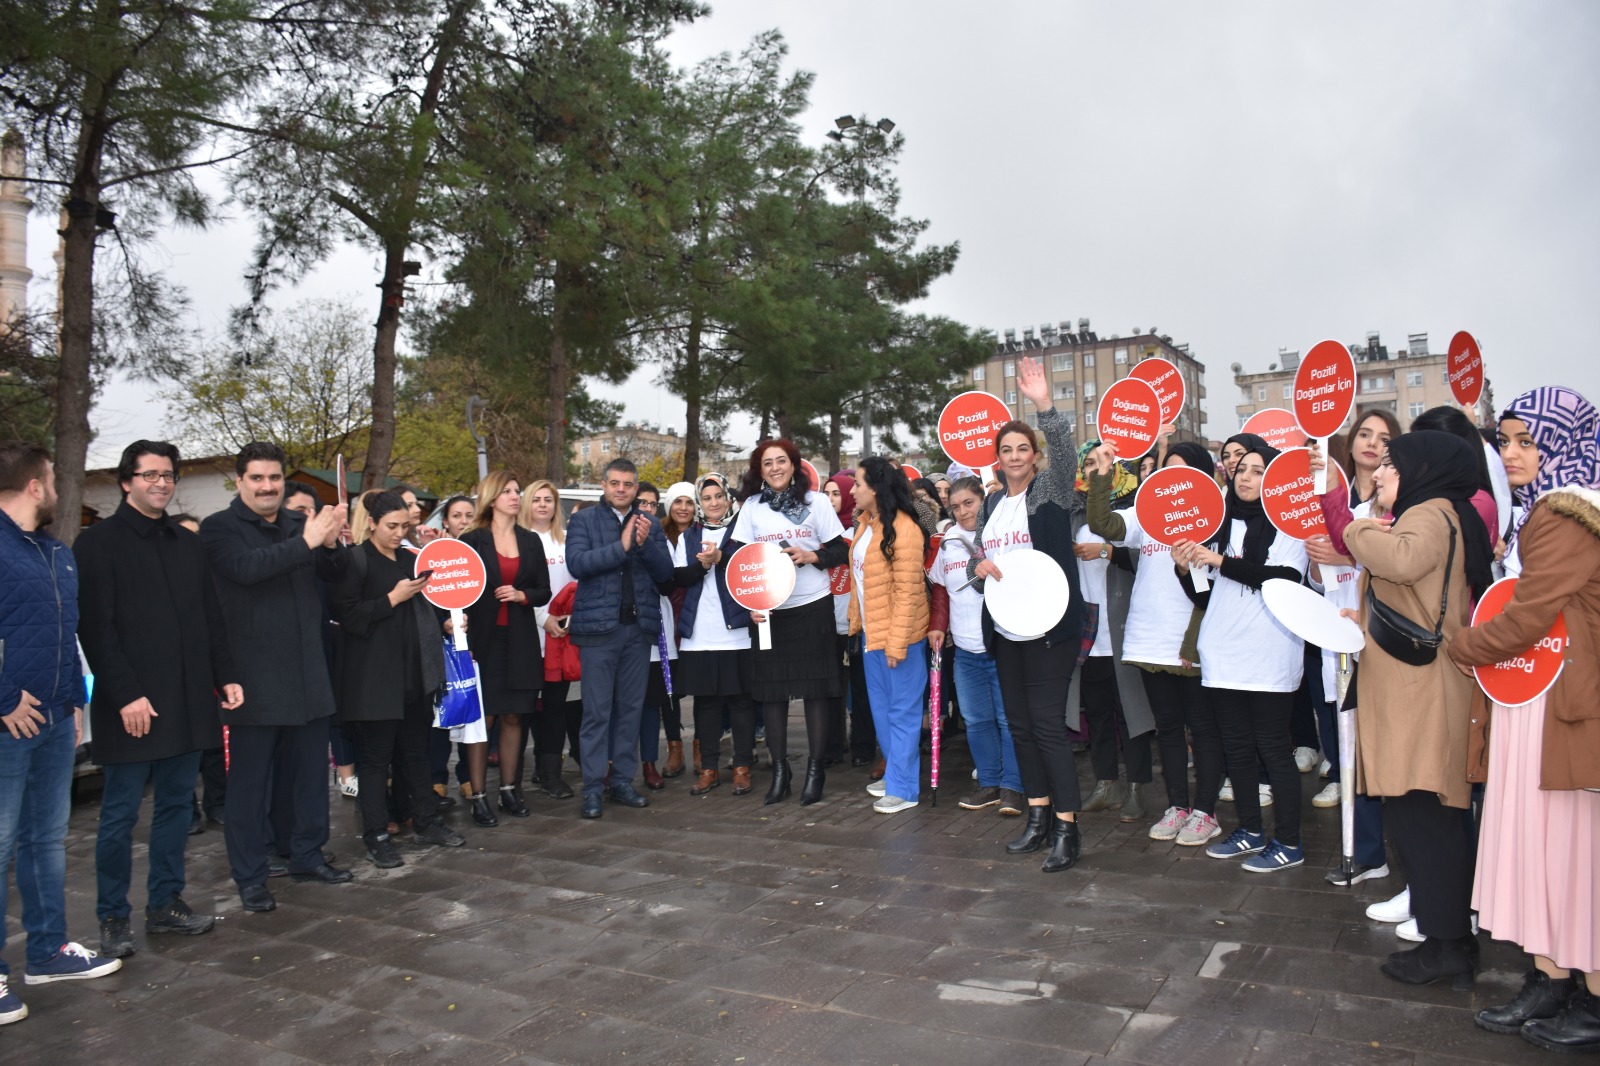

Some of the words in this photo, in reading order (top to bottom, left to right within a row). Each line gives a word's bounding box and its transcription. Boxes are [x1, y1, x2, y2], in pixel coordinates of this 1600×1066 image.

[1310, 362, 1338, 381] Pozitif
[1296, 382, 1336, 401] Doğumlar
[1337, 376, 1352, 392] İçin
[1112, 397, 1150, 413] Doğumda
[1312, 401, 1320, 414] El
[1321, 399, 1335, 412] Ele
[957, 409, 988, 425] Pozitif
[1111, 411, 1147, 427] Kesintisiz
[943, 425, 990, 442] Doğumlar
[1102, 424, 1129, 438] Destek
[1129, 429, 1152, 442] Haktır
[965, 440, 976, 450] El
[976, 437, 993, 448] Ele
[1154, 480, 1194, 498] Sağlıklı
[1264, 481, 1298, 498] Doğuma
[1289, 489, 1315, 504] Doğan
[1170, 497, 1186, 507] ve
[1164, 505, 1200, 523] Bilinçli
[1280, 505, 1310, 521] Doğum
[1309, 501, 1322, 512] Ek
[1163, 523, 1194, 536] Gebe
[1195, 517, 1209, 528] Ol
[1300, 513, 1326, 530] SAYG
[786, 529, 793, 539] 3
[795, 527, 812, 539] Kala
[1004, 533, 1009, 546] 3
[427, 557, 468, 569] Doğumda
[431, 568, 470, 580] Kesintisiz
[426, 582, 456, 594] Destek
[456, 580, 480, 590] Haktır
[735, 585, 765, 596] Destek
